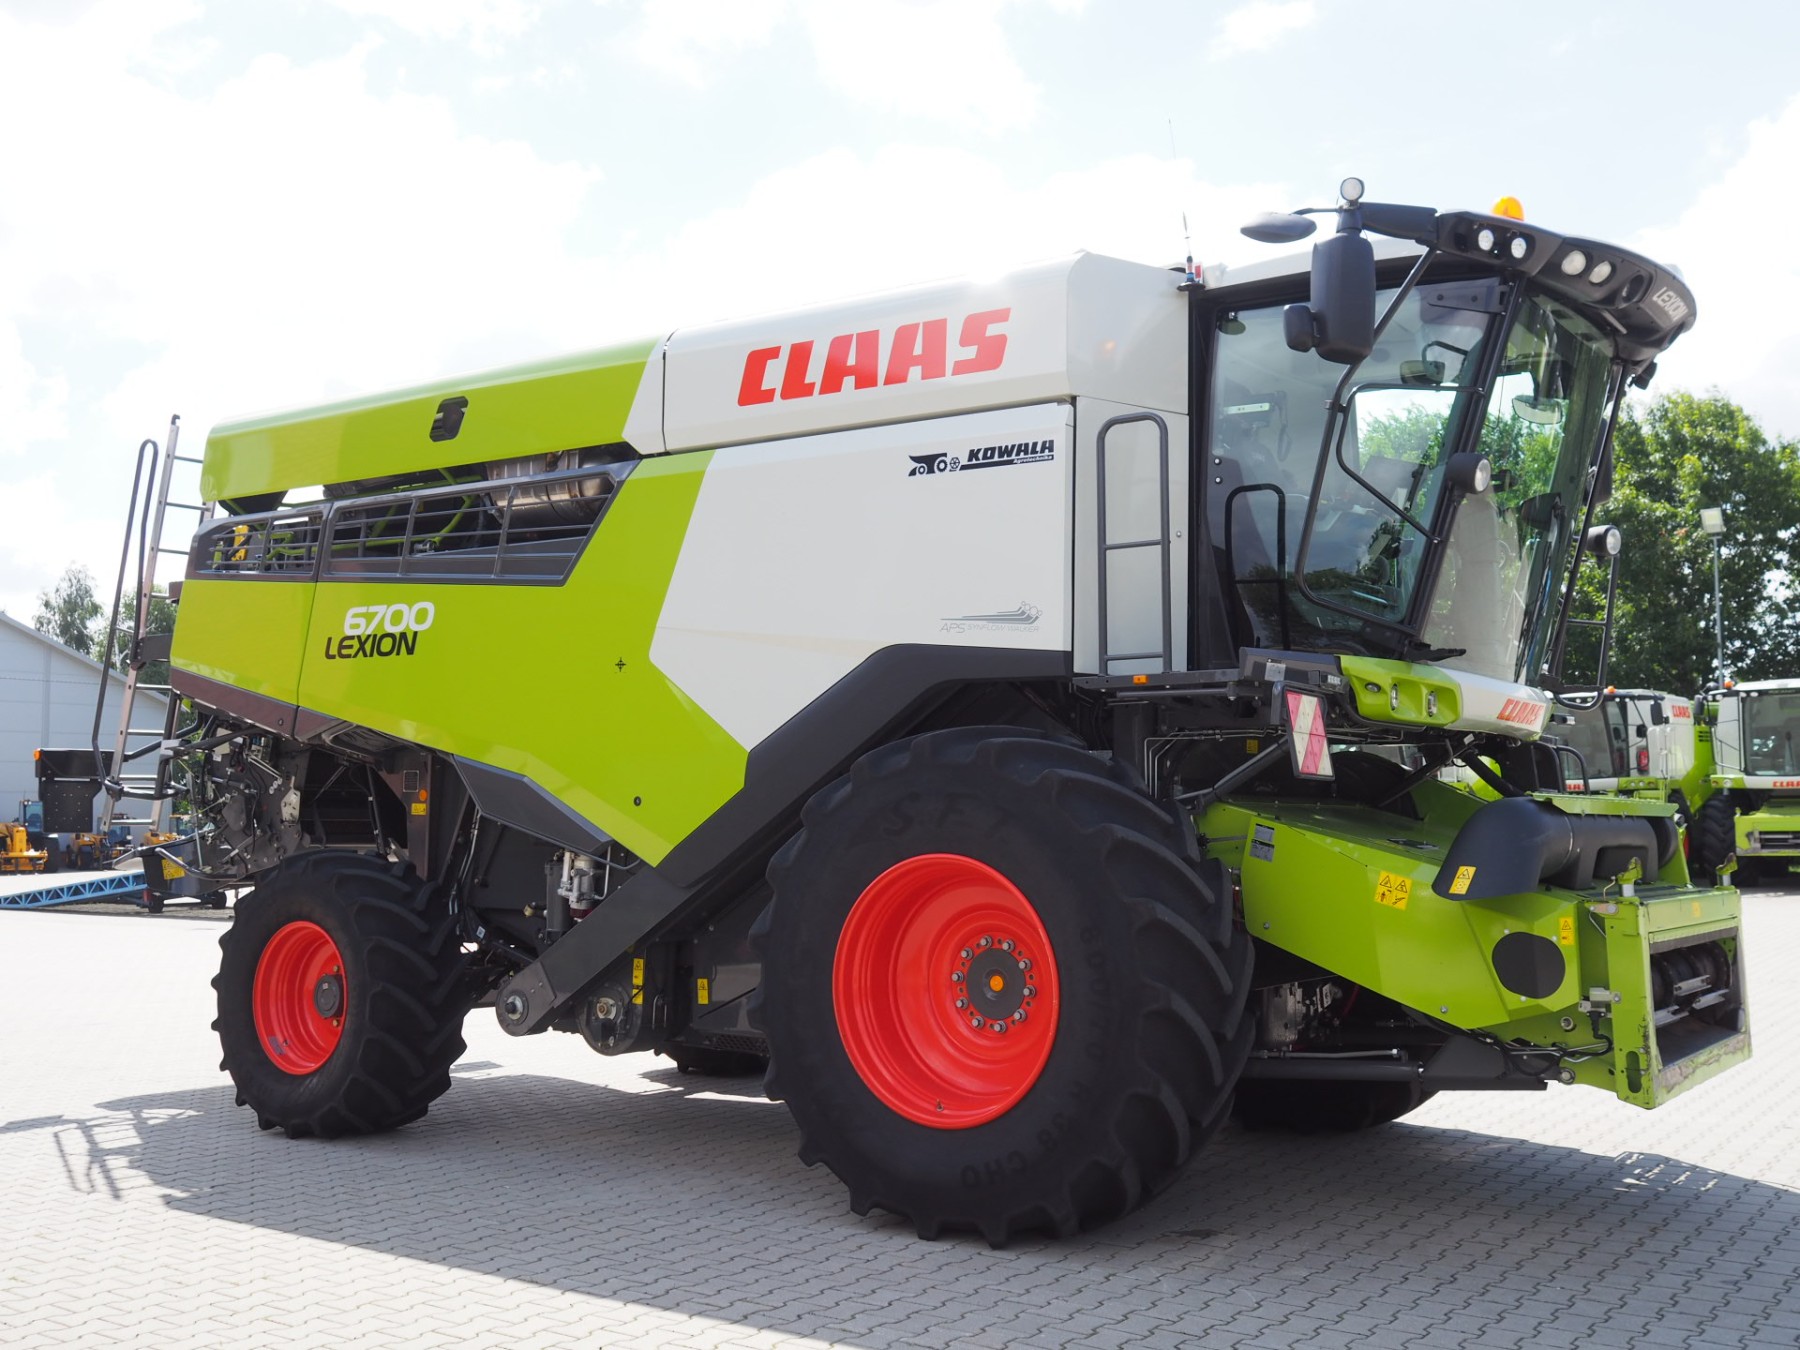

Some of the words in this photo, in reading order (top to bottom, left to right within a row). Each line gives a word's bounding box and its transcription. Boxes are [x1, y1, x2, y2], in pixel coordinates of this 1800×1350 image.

[737, 307, 1011, 406] CLAAS
[967, 439, 1055, 463] KOWALA
[343, 601, 435, 636] 6700
[939, 622, 967, 634] APS
[324, 630, 418, 660] LEXION
[1496, 698, 1546, 726] CLAAS
[1671, 704, 1691, 719] CLAAS
